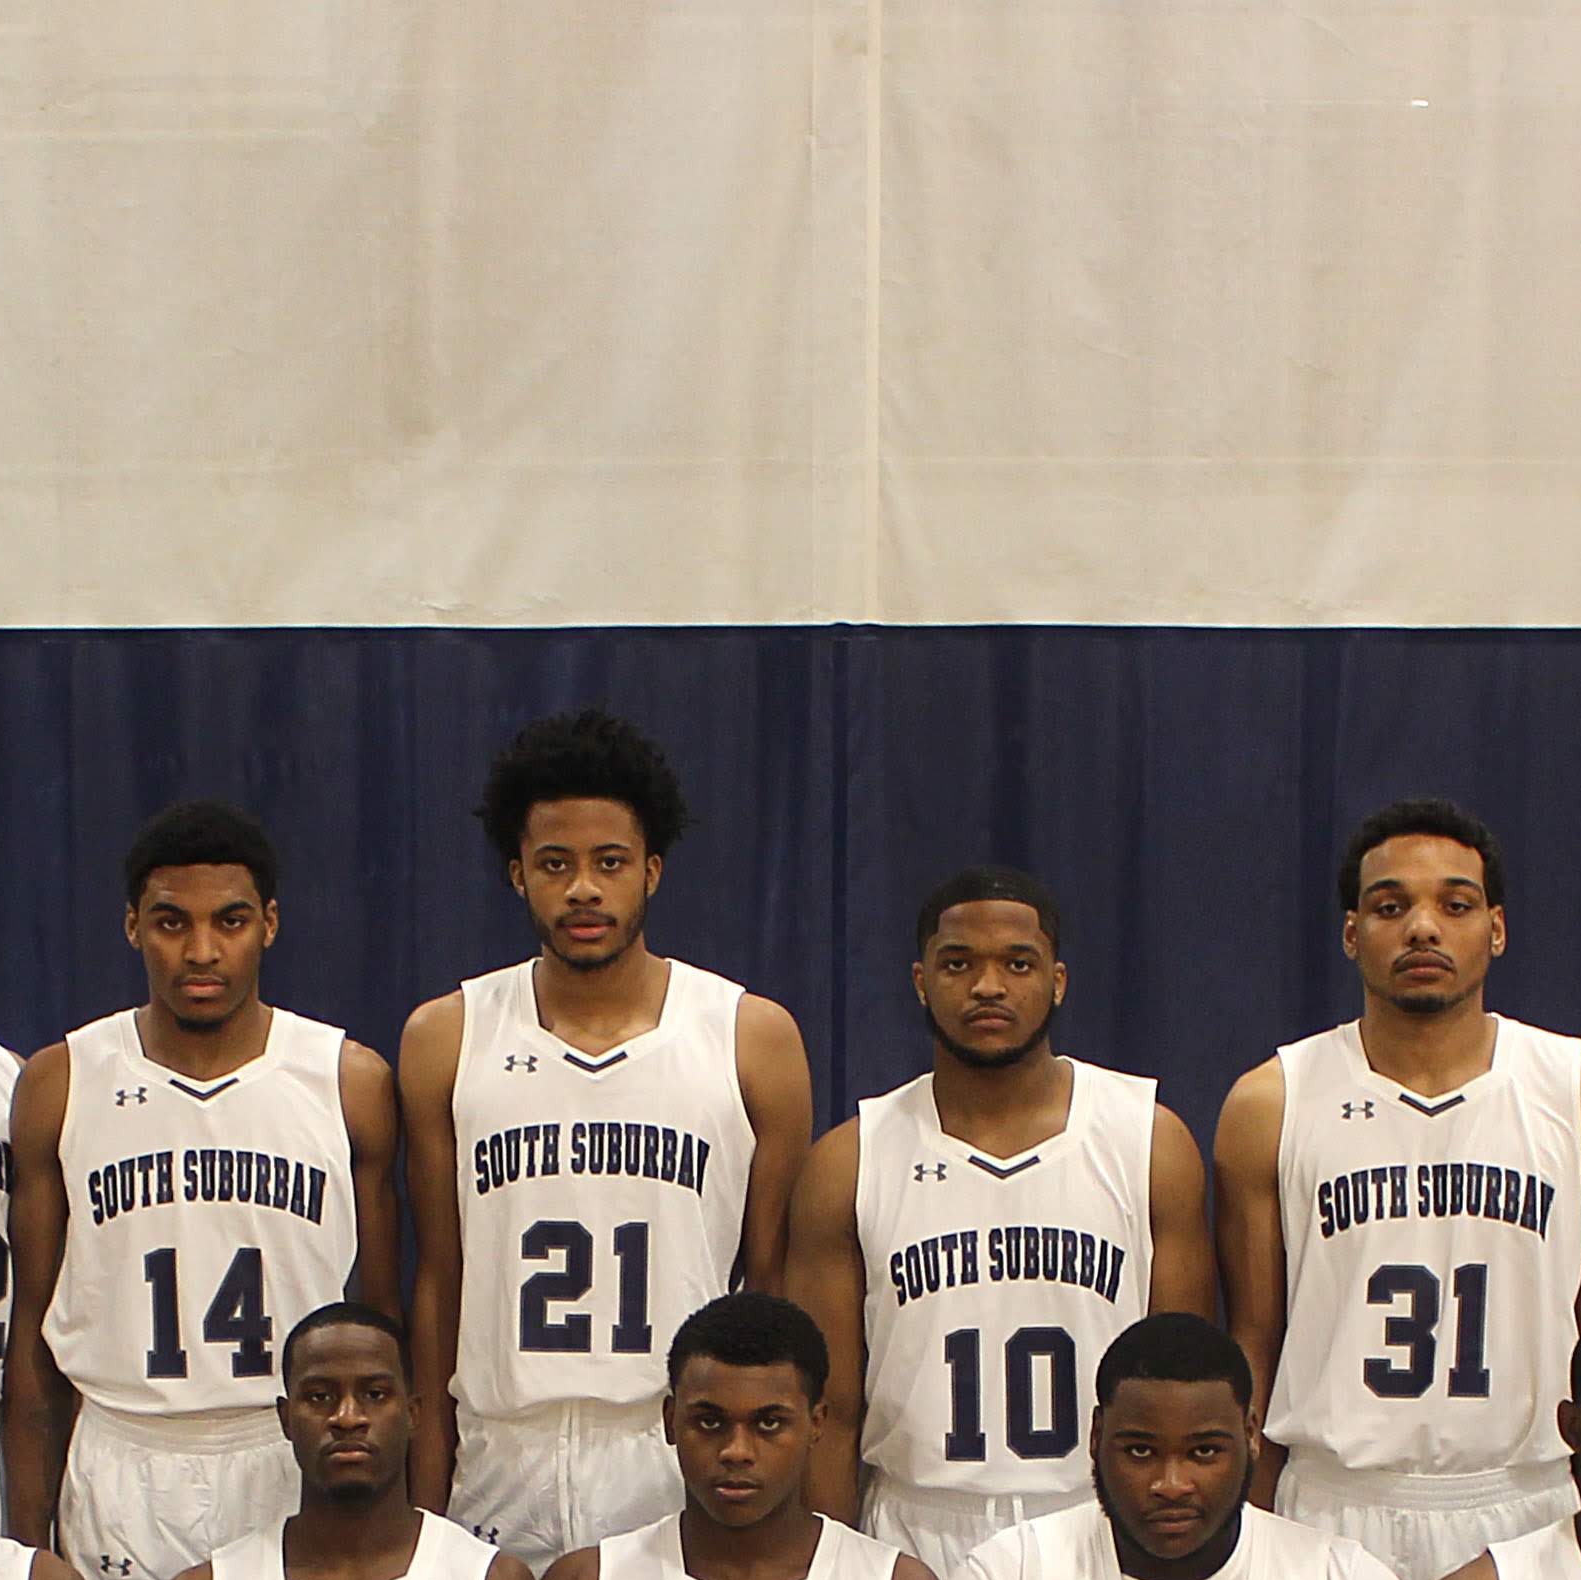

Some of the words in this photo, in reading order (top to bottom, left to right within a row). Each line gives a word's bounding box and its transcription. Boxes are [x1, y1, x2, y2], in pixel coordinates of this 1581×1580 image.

[88, 1150, 175, 1226] SOUTH
[184, 1149, 327, 1226] SUBURBAN
[475, 1123, 561, 1195] SOUTH
[571, 1122, 710, 1199] SUBURBAN
[1318, 1165, 1408, 1239] SOUTH
[1417, 1163, 1555, 1242] SUBURBAN
[143, 1247, 273, 1379] 14
[519, 1220, 652, 1353] 21
[890, 1230, 979, 1307] SOUTH
[988, 1226, 1126, 1305] SUBURBAN
[1362, 1262, 1491, 1398] 31
[943, 1325, 1080, 1462] 10
